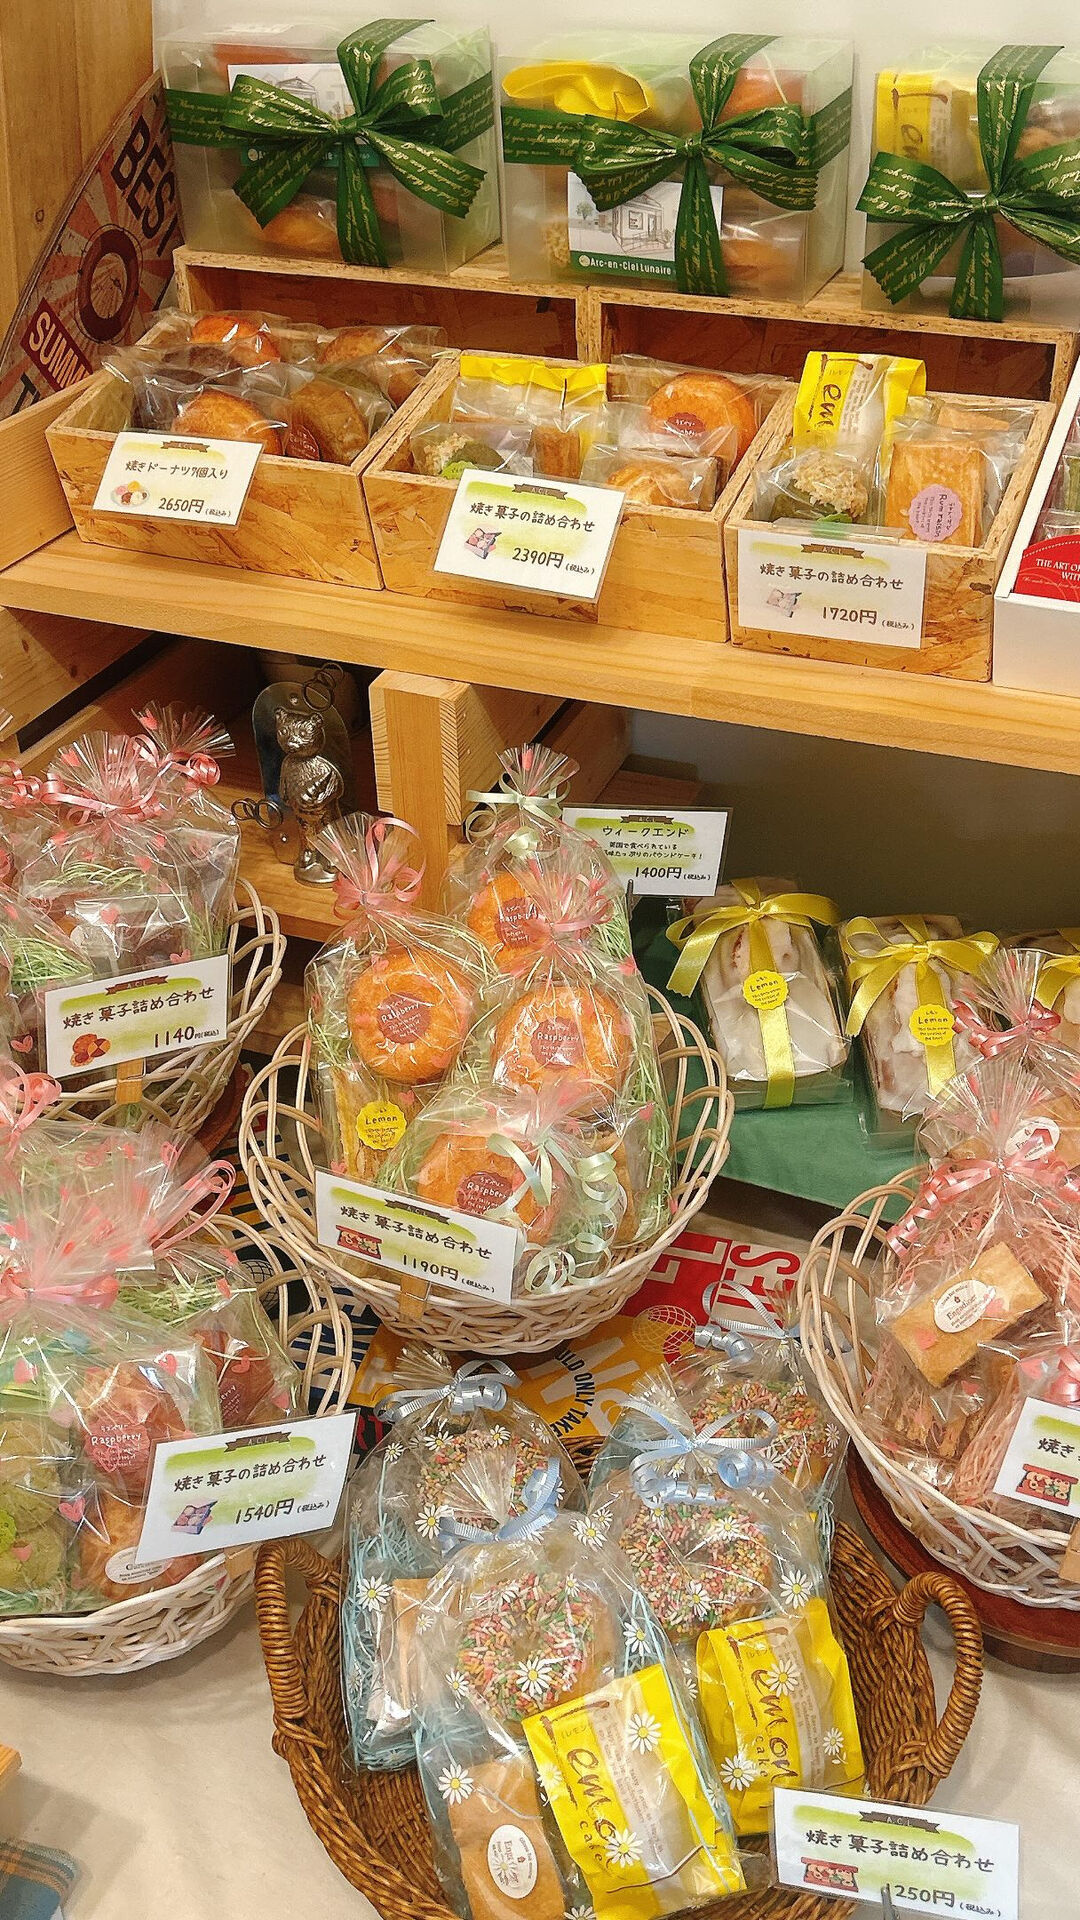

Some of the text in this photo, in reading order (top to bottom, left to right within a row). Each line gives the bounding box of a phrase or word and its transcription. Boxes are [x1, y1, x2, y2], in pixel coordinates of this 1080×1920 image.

[111, 115, 178, 257] BEST
[158, 497, 205, 514] 2650円
[470, 501, 595, 532] 焼き菓子の詰め合わせ
[512, 547, 595, 575] 2390円 (税込み)
[1036, 558, 1052, 568] THE
[1053, 561, 1069, 571] ART
[759, 562, 904, 590] 焼き菓子の詰め合わせ
[822, 606, 916, 631] 1720円 (税込み)
[602, 826, 689, 838] ウィークエンド
[634, 866, 682, 880] 1400円
[750, 980, 779, 993] Lemon
[63, 986, 215, 1030] 焼き菓子詰め合わせ
[918, 1016, 949, 1025] Lemon
[537, 1031, 580, 1043] Raspberry
[365, 1115, 398, 1125] Lemon
[340, 1205, 493, 1260] 焼き菓子詰め合わせ
[402, 1254, 459, 1282] 1190円
[573, 1372, 596, 1407] ONLY
[549, 1407, 590, 1438] TAKE
[91, 1432, 141, 1446] Raspberry
[173, 1453, 327, 1493] 焼き菓子の詰め合わせ
[235, 1498, 331, 1525] 1540円 (税込み)
[754, 1734, 770, 1779] cake
[806, 1829, 994, 1873] 焼き菓子詰め合わせ
